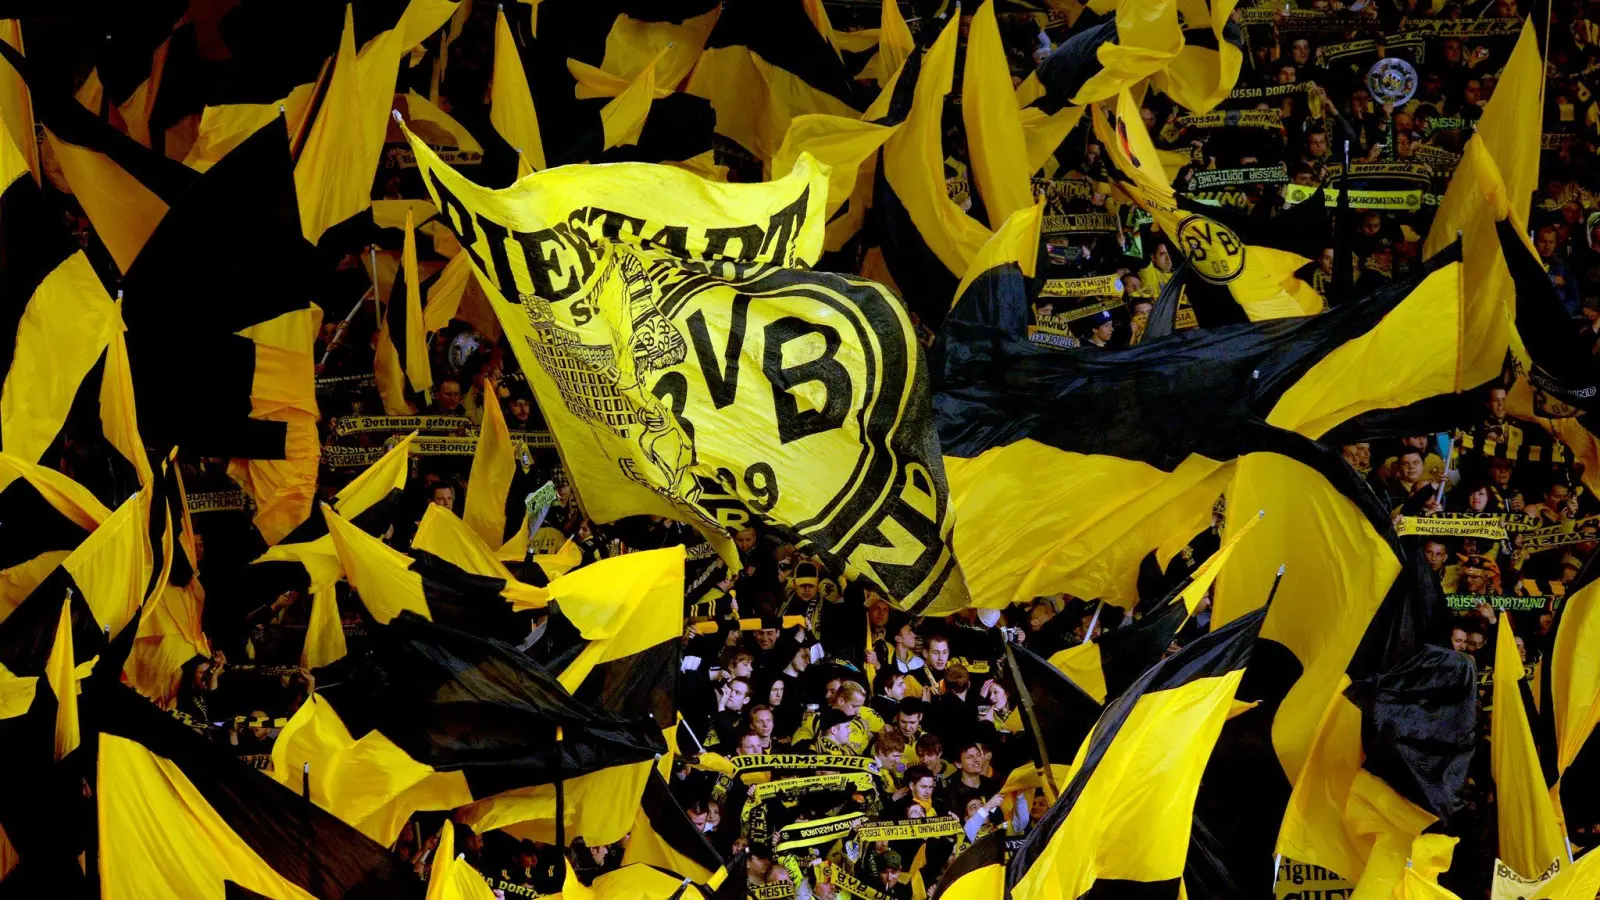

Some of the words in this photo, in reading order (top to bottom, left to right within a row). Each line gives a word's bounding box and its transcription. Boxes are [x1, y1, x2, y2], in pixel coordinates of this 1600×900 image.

[1348, 195, 1404, 205] DORTMUND
[1186, 222, 1239, 262] BVB
[1211, 260, 1230, 274] 09
[1065, 277, 1112, 289] DORTMUND
[362, 417, 422, 429] Dortmund
[420, 444, 477, 452] SEEBORUS
[884, 828, 900, 836] CARL
[918, 823, 950, 834] DORTMUND
